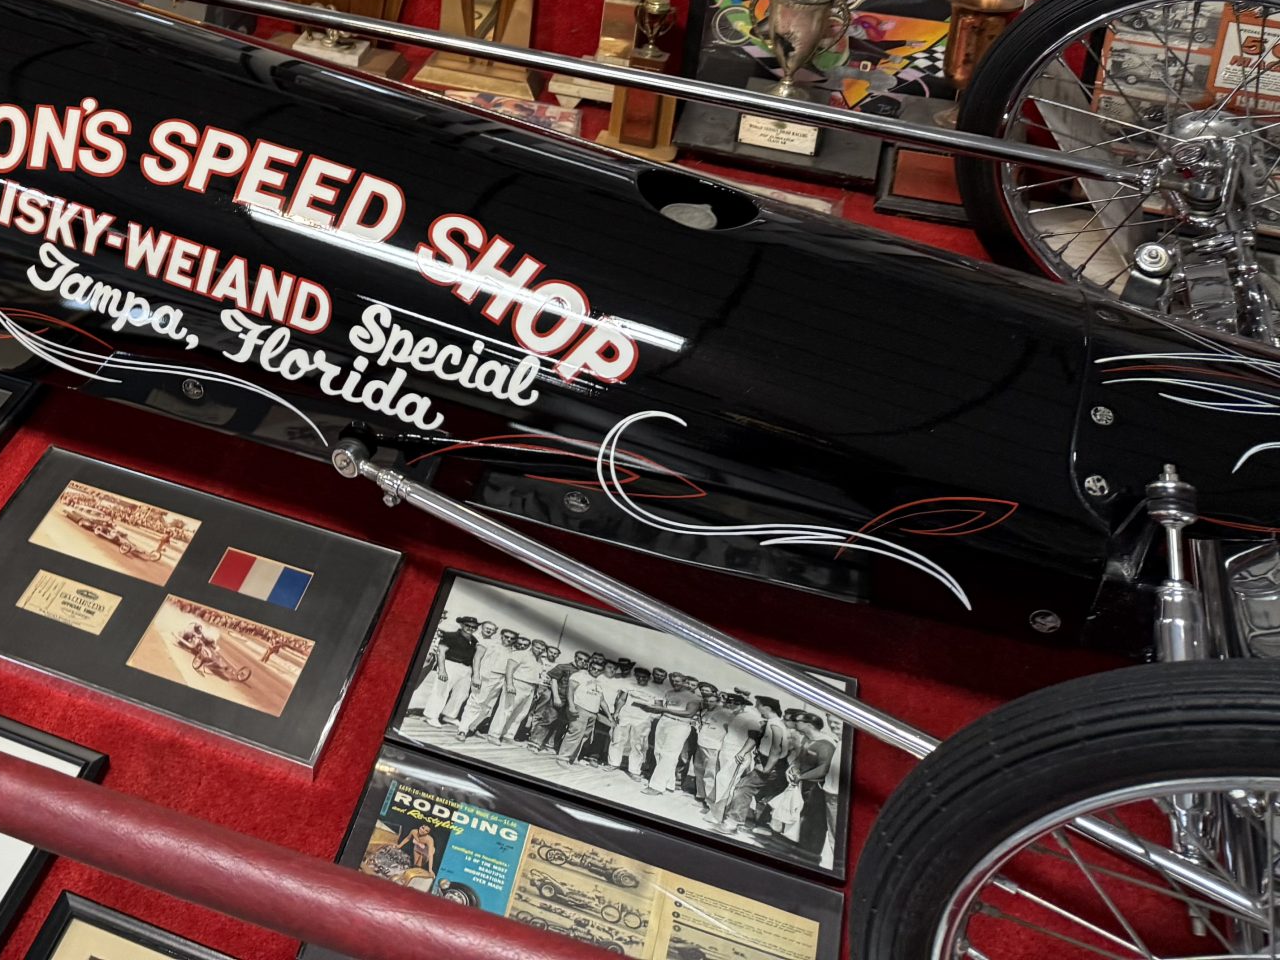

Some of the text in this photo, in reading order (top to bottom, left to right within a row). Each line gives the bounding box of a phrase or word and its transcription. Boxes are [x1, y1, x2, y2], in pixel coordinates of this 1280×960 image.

[140, 118, 407, 245] SPEED
[416, 213, 639, 383] SHOP
[26, 242, 446, 431] Tampa, Florida
[348, 303, 540, 408] Special
[391, 805, 407, 814] and
[394, 791, 519, 842] RODDING
[472, 876, 503, 891] EVER MADE
[481, 860, 492, 868] THE
[492, 864, 508, 874] MOST
